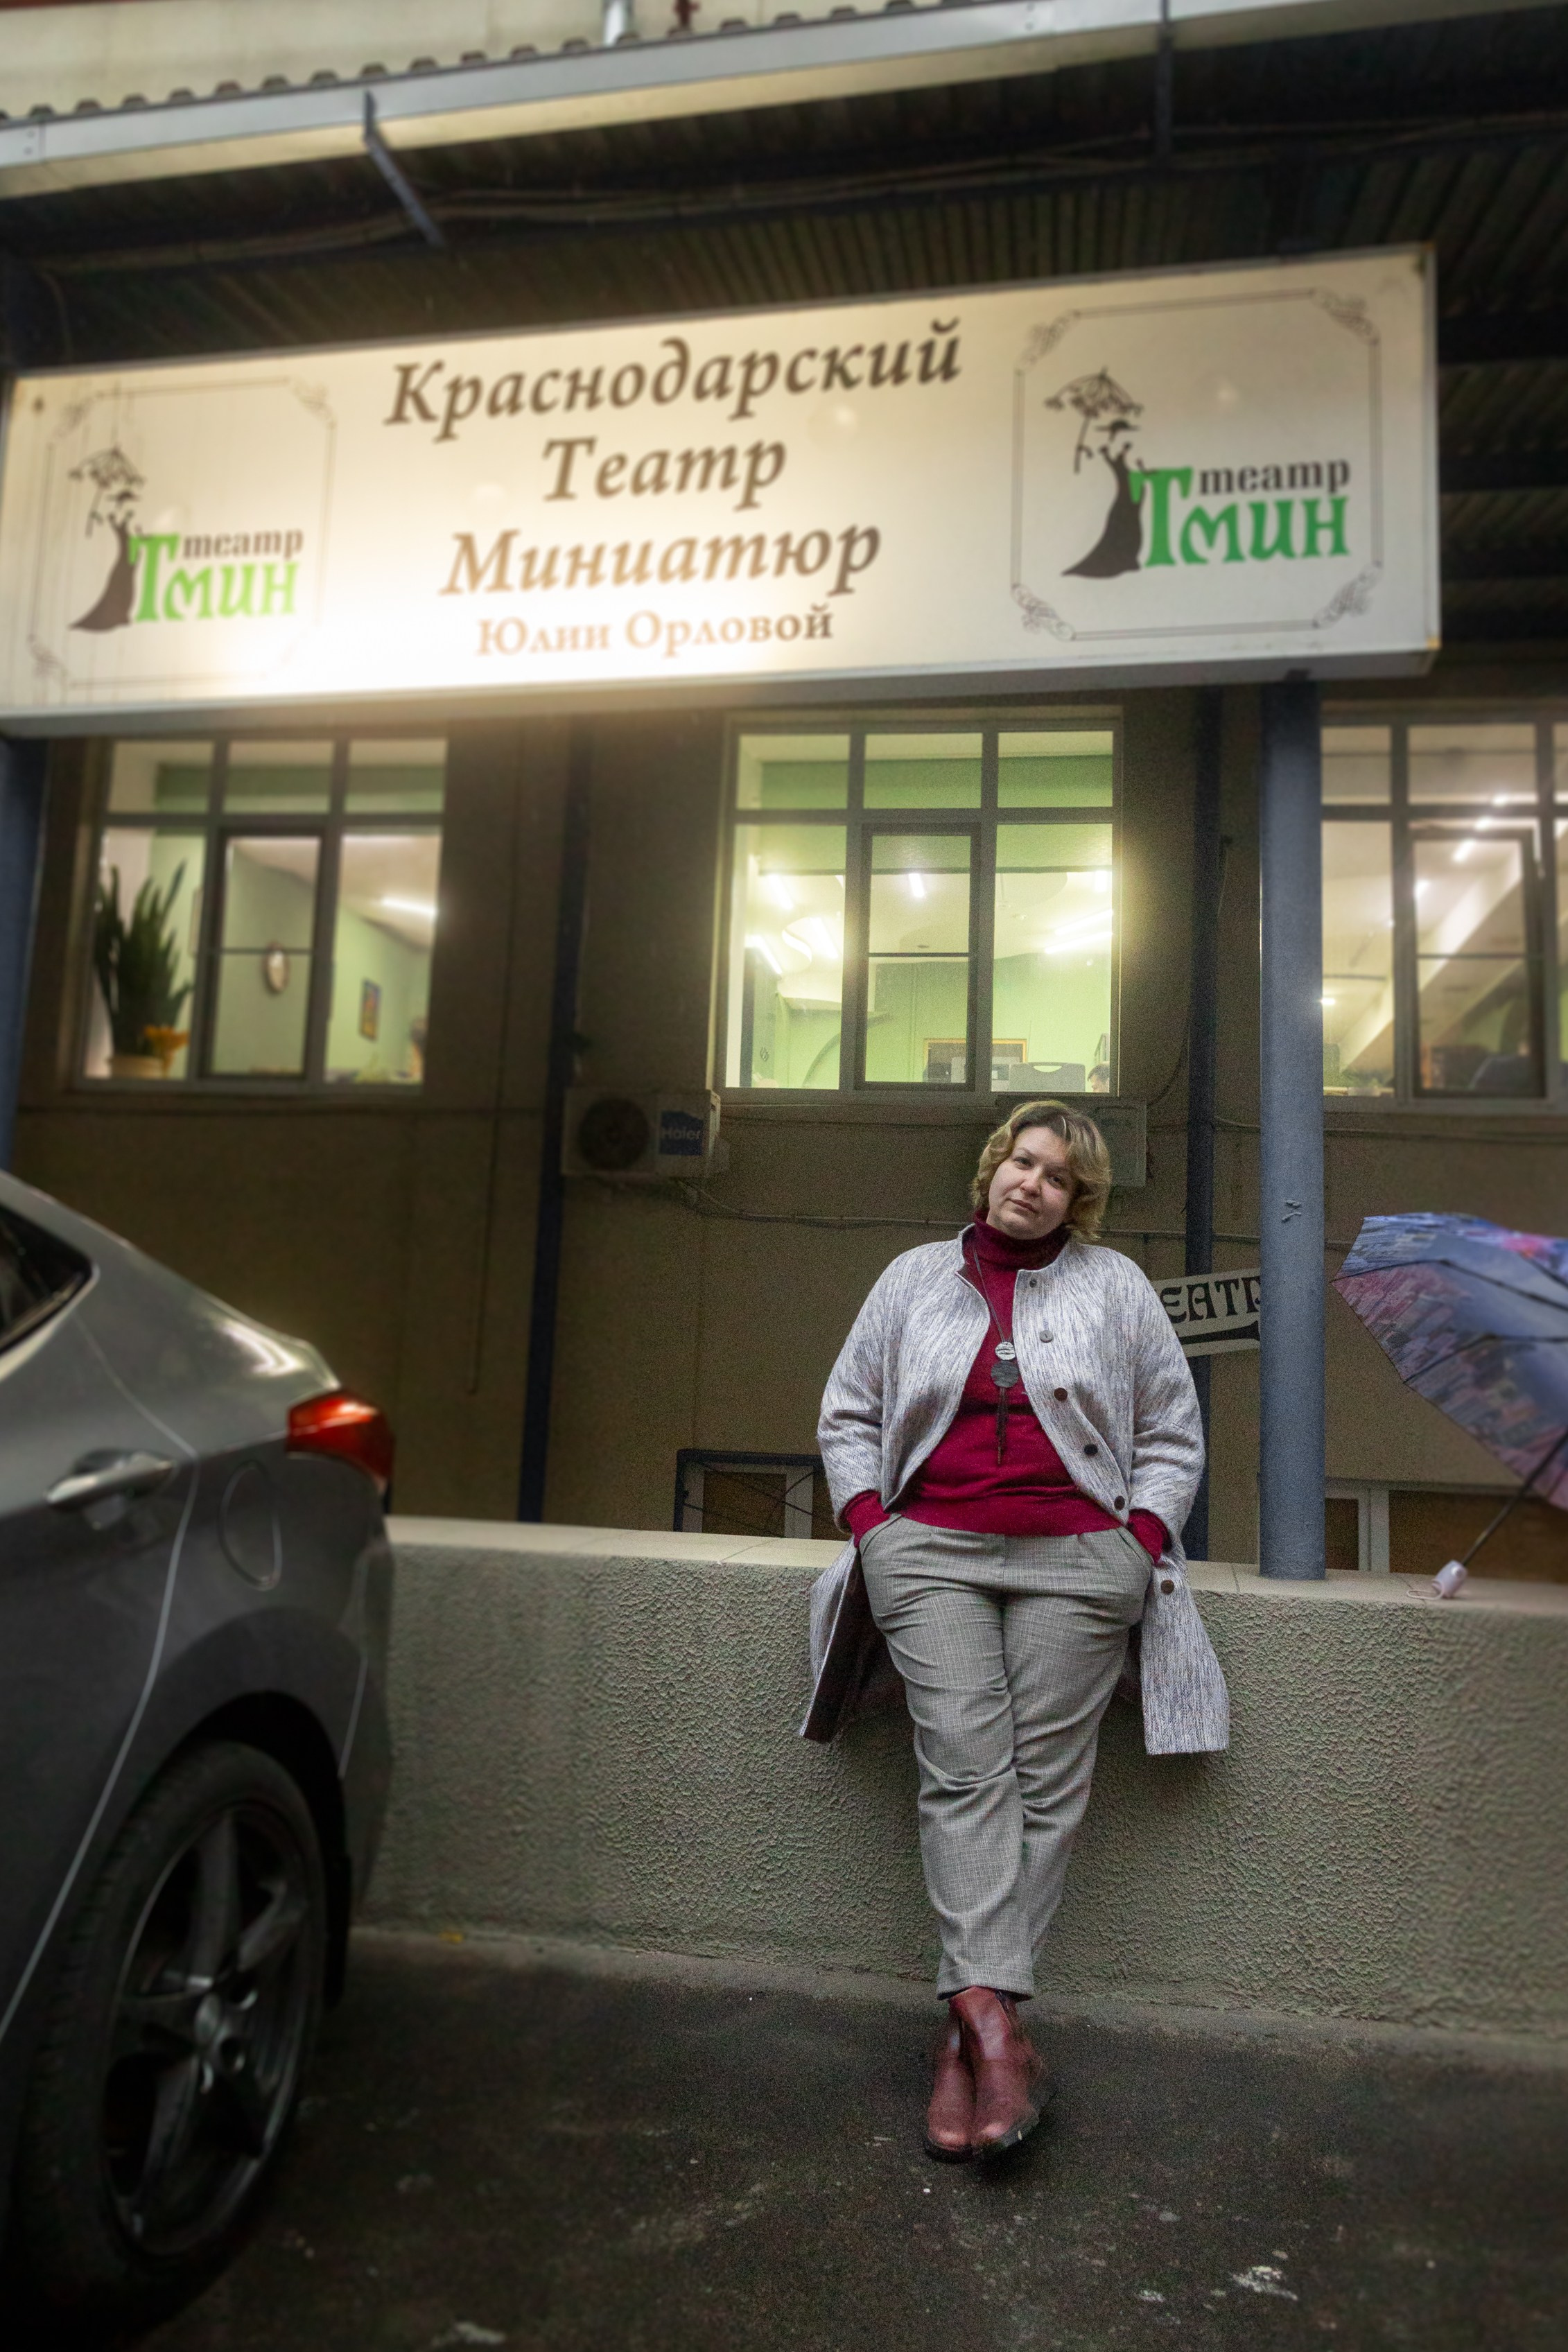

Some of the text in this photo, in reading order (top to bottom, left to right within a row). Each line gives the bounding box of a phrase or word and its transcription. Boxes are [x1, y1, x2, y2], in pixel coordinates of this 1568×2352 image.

[384, 317, 962, 442] Краснодарский
[542, 436, 787, 510] Театр
[1199, 460, 1350, 496] театр
[184, 530, 304, 559] театр
[438, 524, 882, 598] Миниатюр
[476, 603, 833, 657] Юлии Орловой
[1154, 1276, 1261, 1324] ЕАТР
